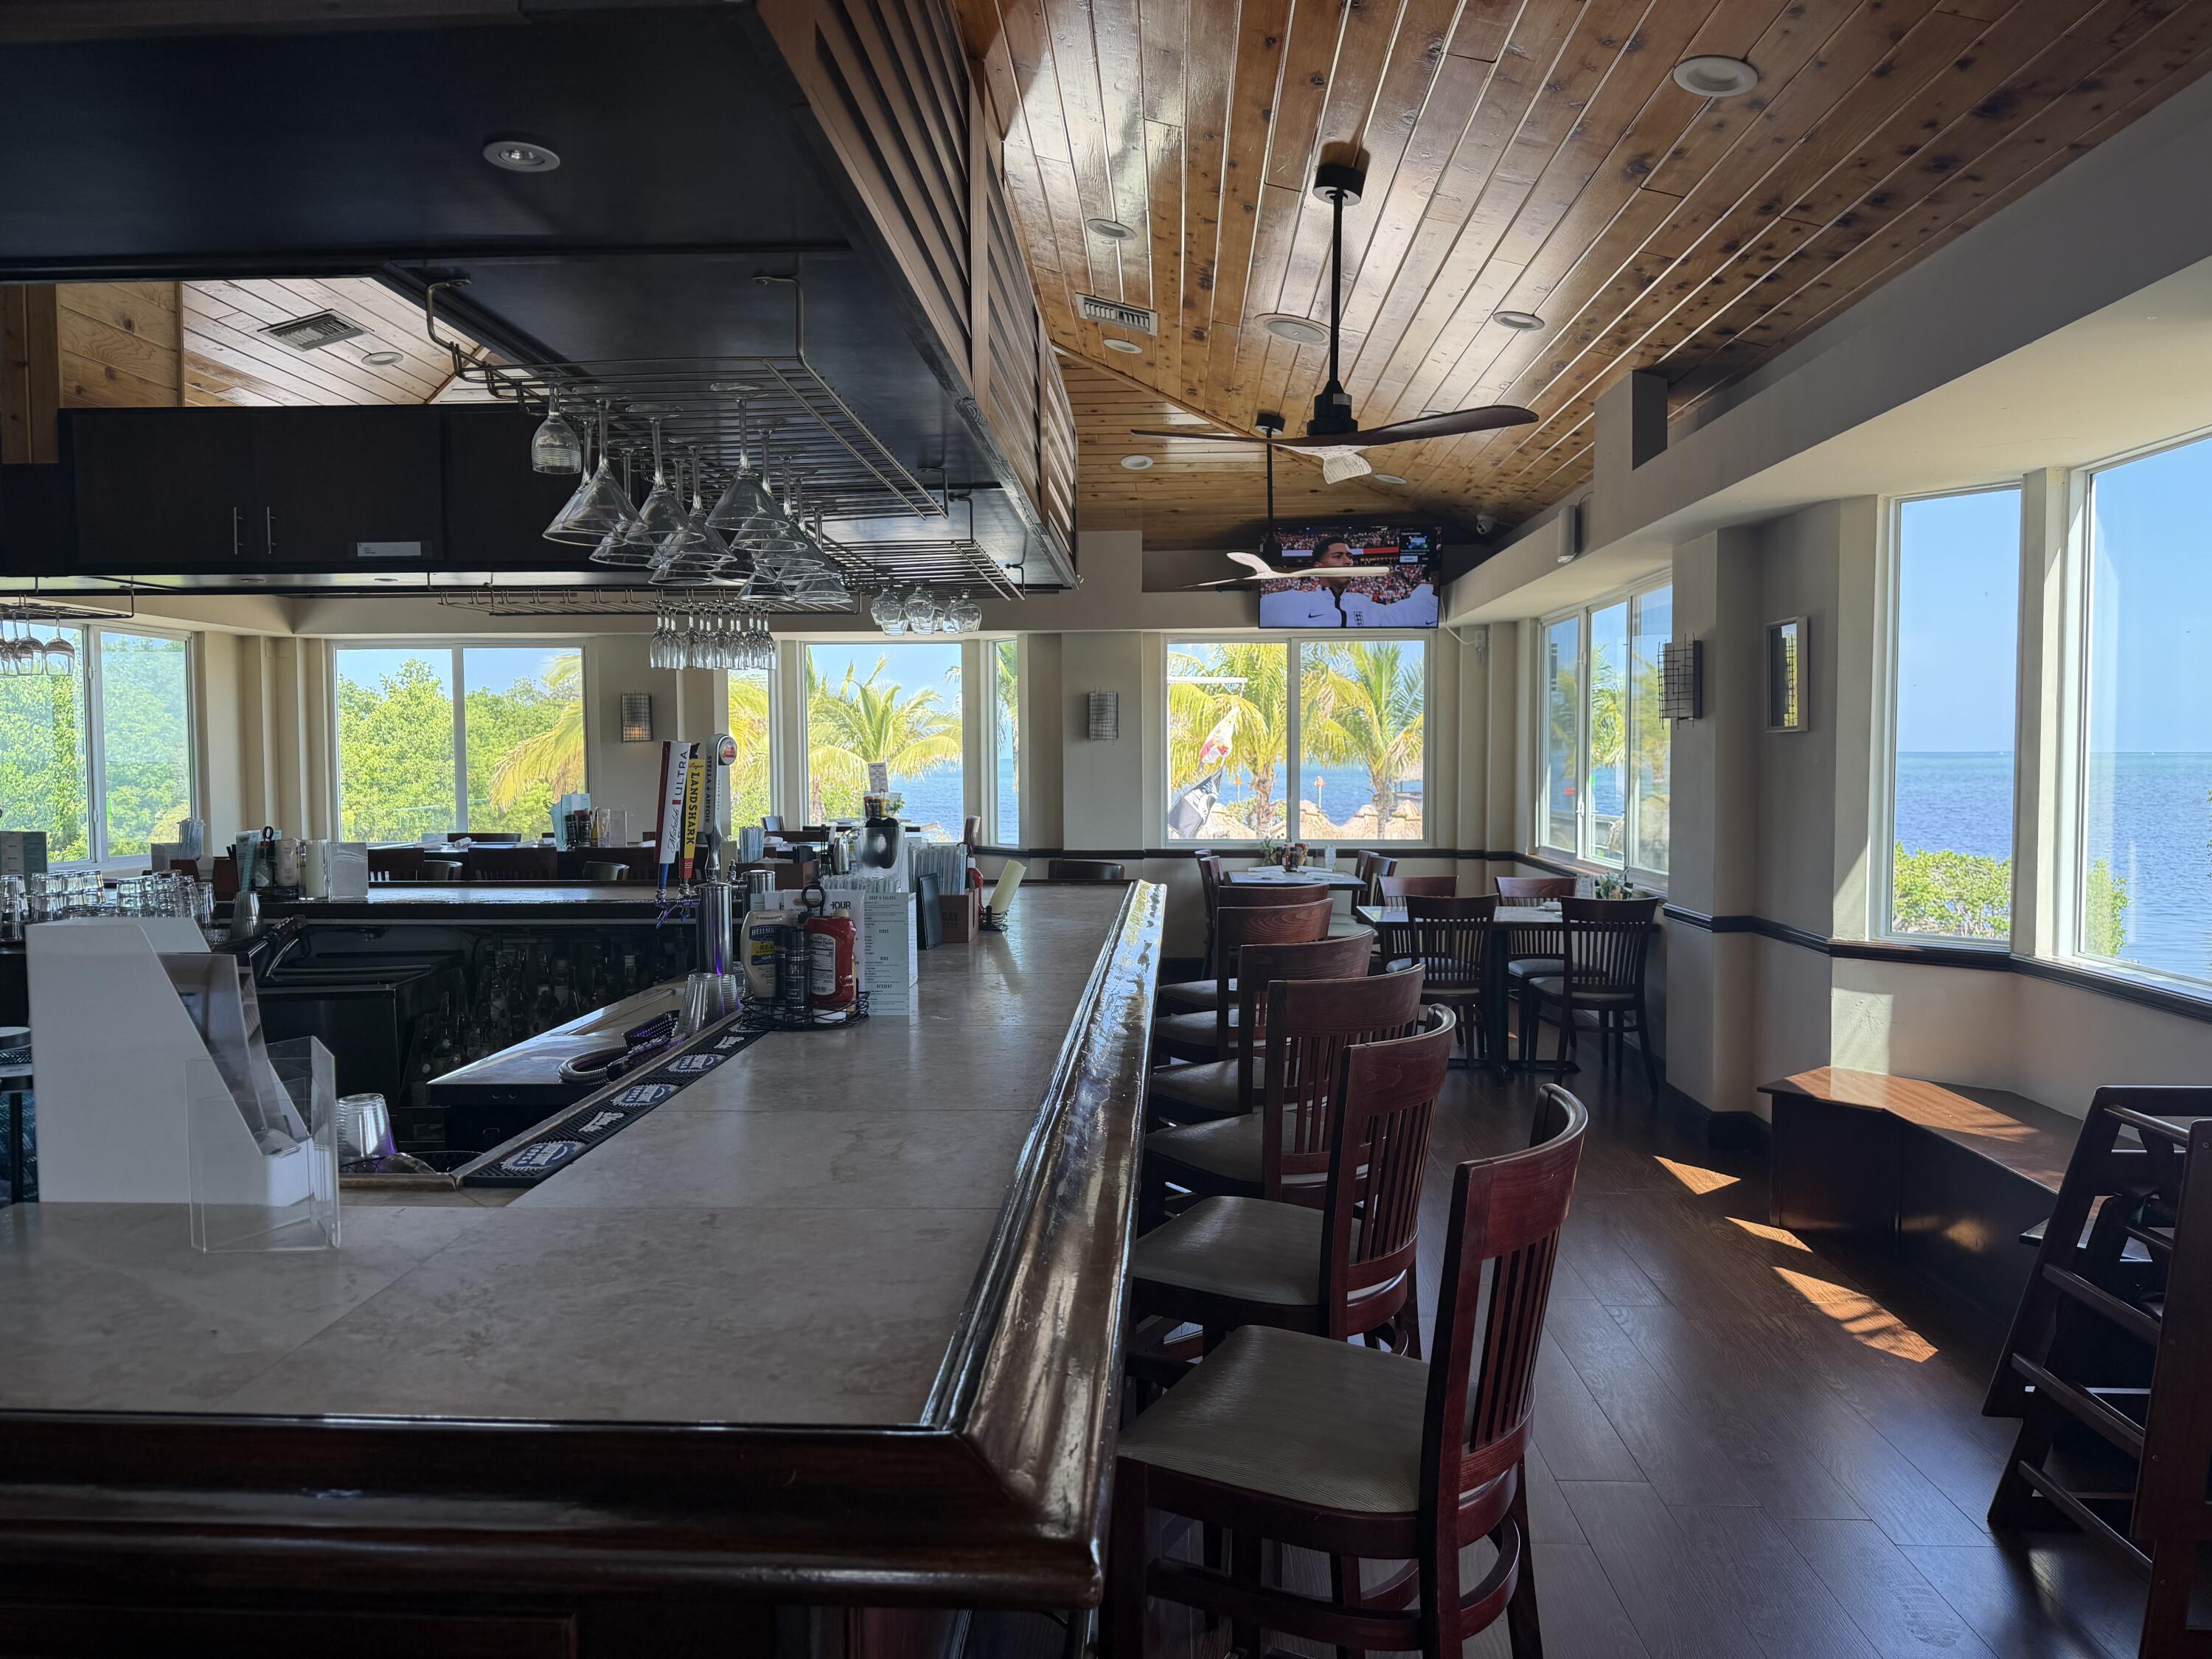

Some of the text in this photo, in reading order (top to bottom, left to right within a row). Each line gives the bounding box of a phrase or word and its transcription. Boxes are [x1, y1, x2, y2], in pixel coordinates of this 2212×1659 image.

[688, 762, 704, 771] Lager
[667, 751, 688, 853] Michelob ULTRA
[686, 772, 700, 845] LANDSHARK
[705, 794, 713, 823] ARTOIS
[751, 928, 775, 936] HELLMA
